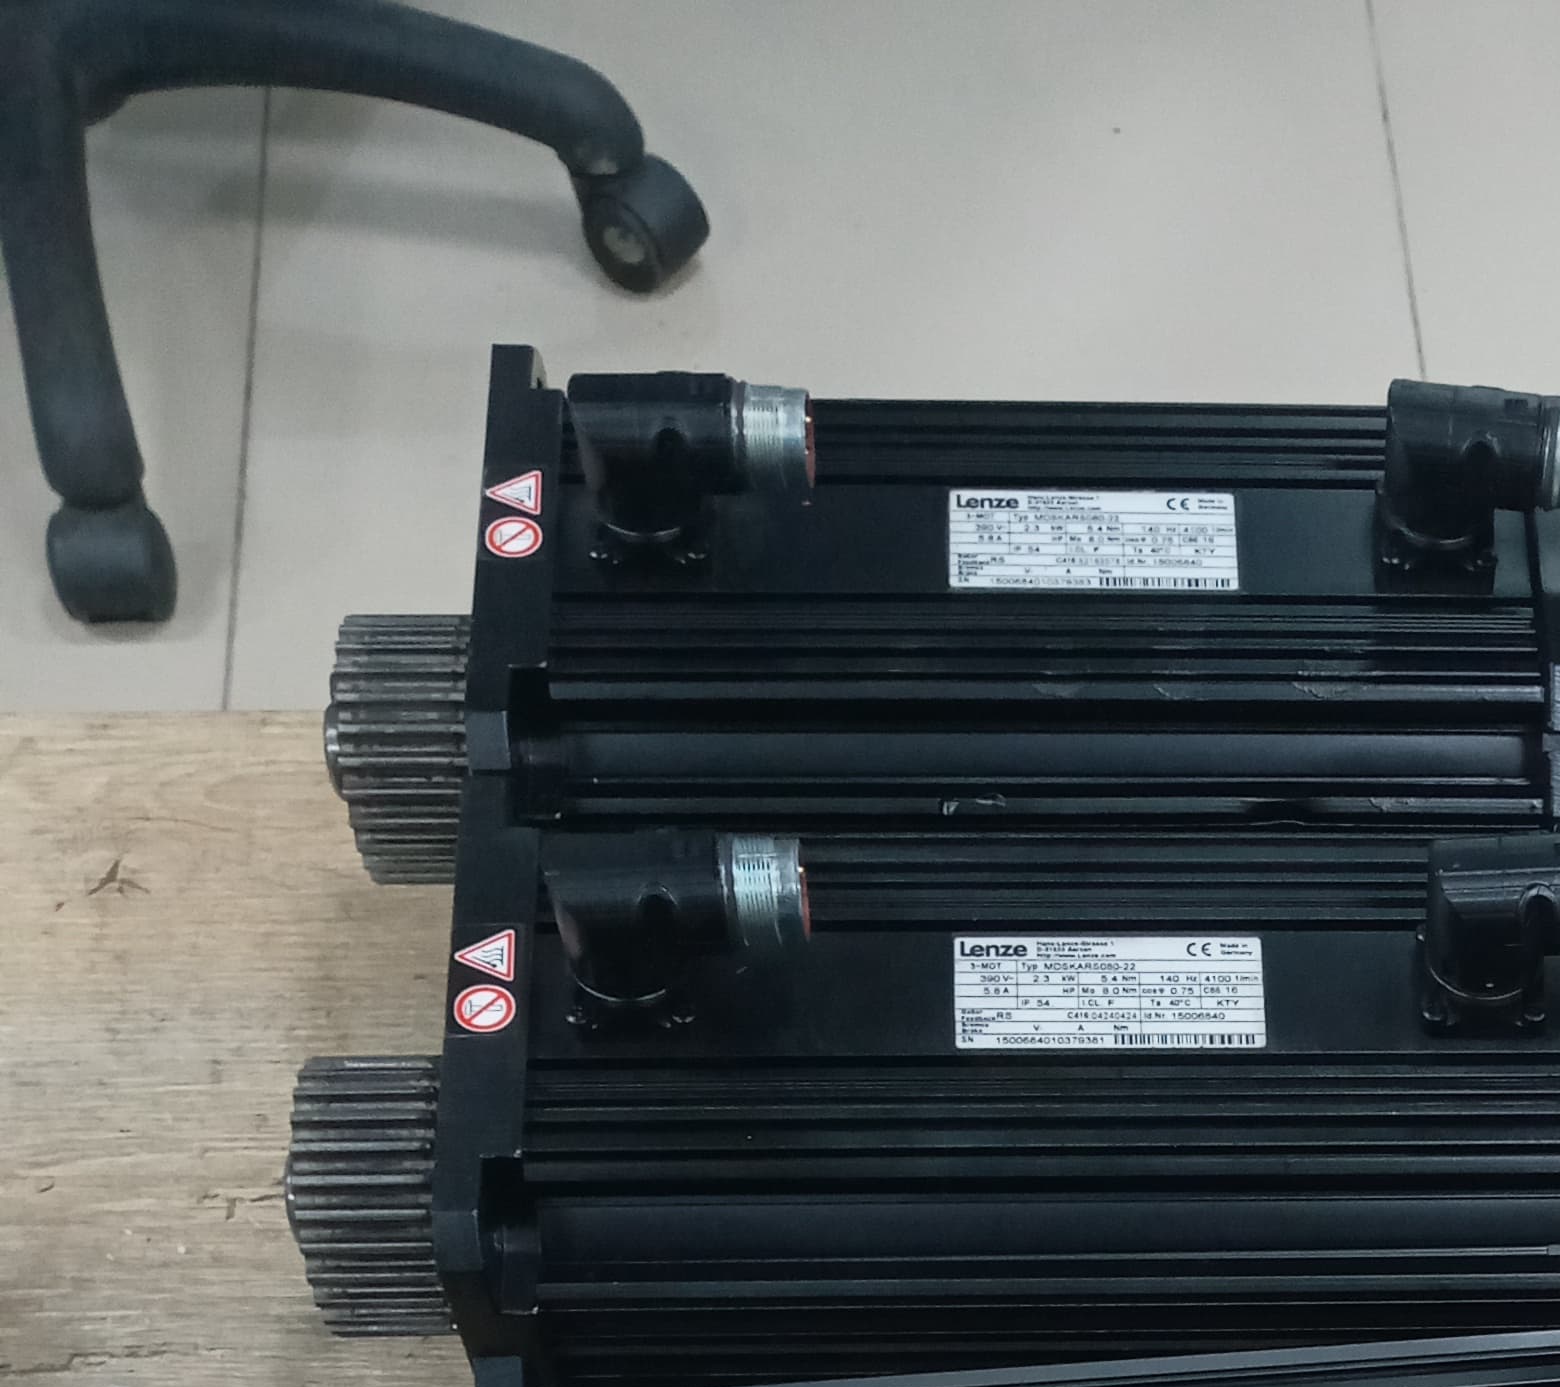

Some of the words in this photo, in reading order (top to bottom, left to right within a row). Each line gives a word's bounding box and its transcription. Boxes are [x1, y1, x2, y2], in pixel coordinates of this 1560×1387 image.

[956, 494, 1019, 509] Lenze
[960, 941, 1028, 958] Lenze
[1021, 962, 1038, 971] Typ
[979, 975, 1000, 983] 390
[1160, 975, 1179, 983] 140
[1205, 975, 1232, 983] 4100
[1003, 986, 1009, 994] A
[1036, 999, 1050, 1007] 54
[996, 1011, 1012, 1020] RS
[1172, 1012, 1226, 1020] 15006840
[1078, 1024, 1084, 1032] A
[1113, 1024, 1128, 1032] Nm
